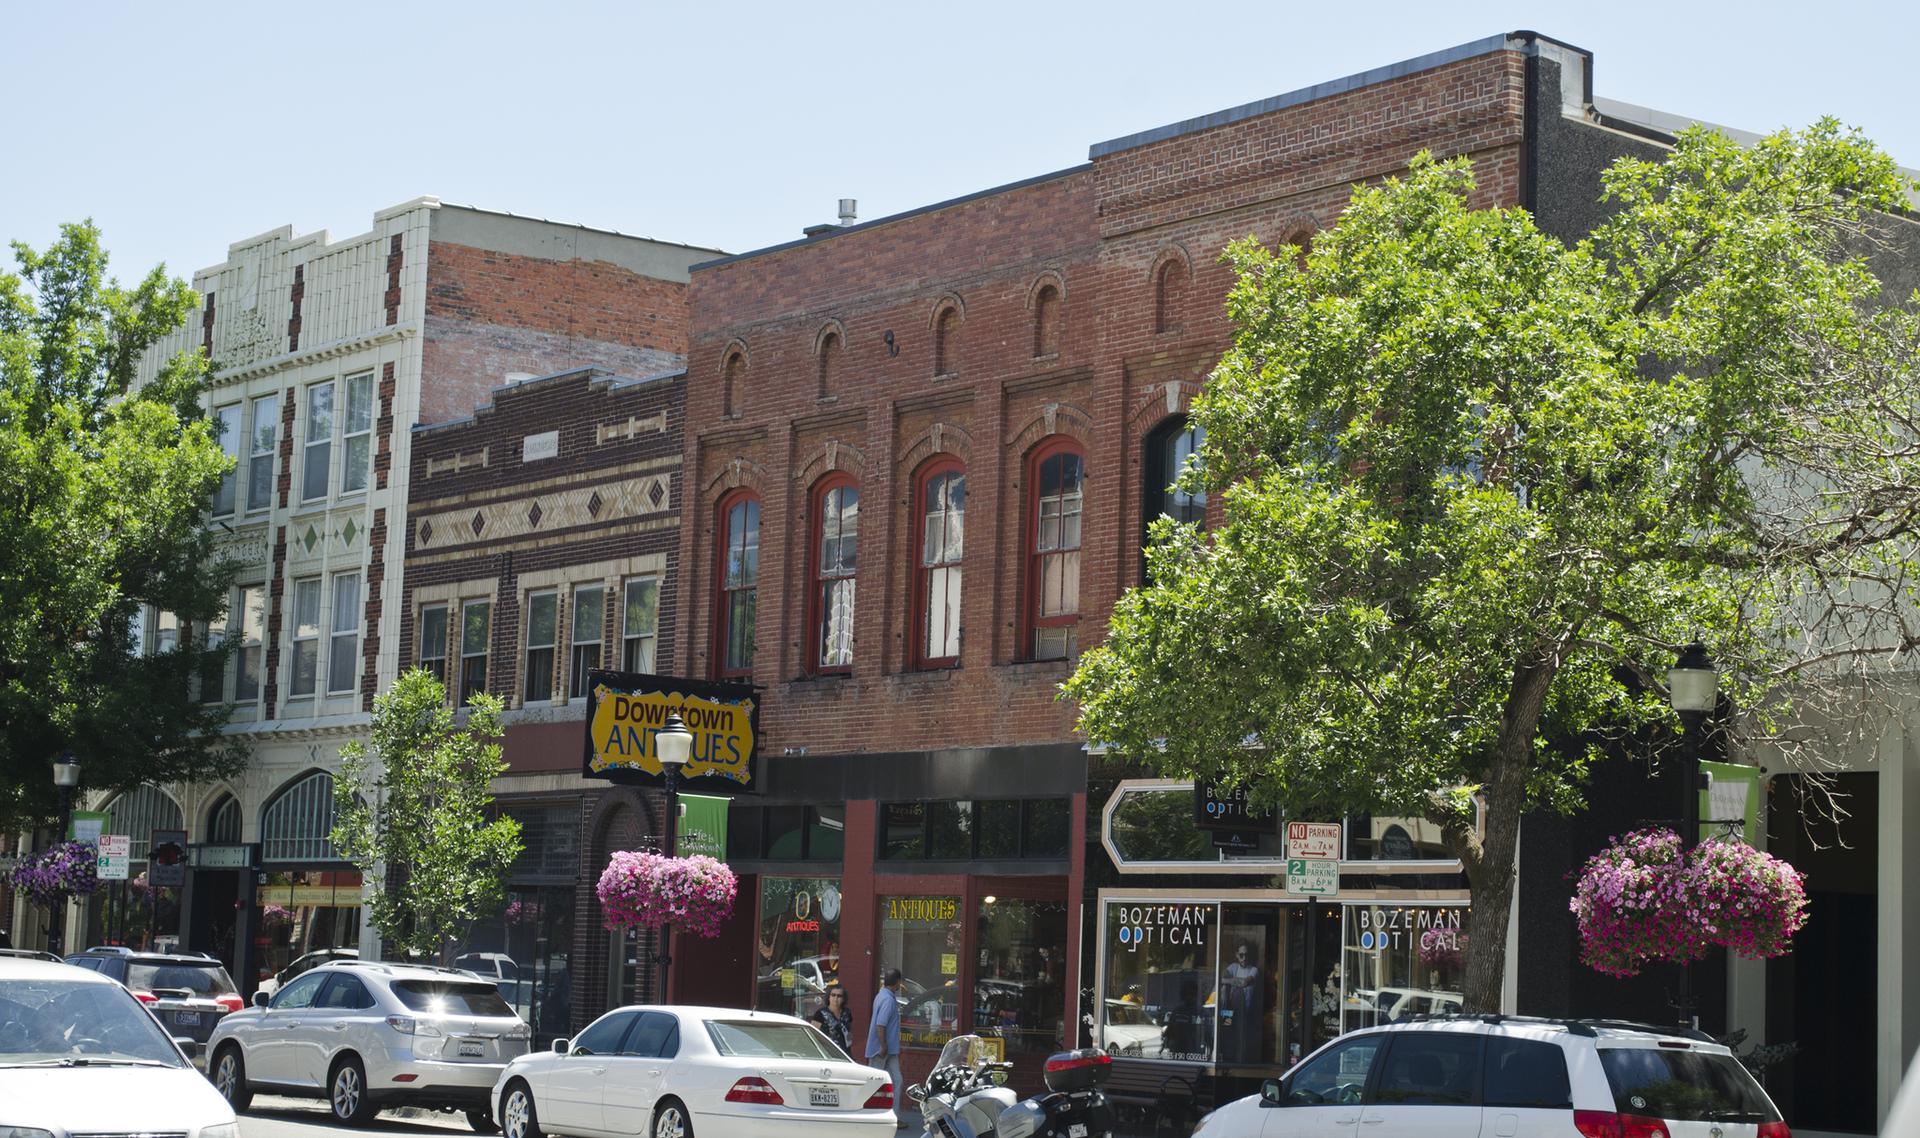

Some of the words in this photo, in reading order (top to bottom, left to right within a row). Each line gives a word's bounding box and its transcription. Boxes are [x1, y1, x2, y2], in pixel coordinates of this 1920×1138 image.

[614, 696, 734, 731] Downtown
[604, 724, 741, 769] ANTUES
[1206, 801, 1271, 819] OPTICL
[1291, 824, 1305, 838] NO
[1308, 827, 1338, 838] PARKING
[101, 836, 110, 845] NO
[1291, 861, 1301, 874] 2
[1306, 868, 1336, 877] PARKING
[889, 899, 956, 922] ANTIQUES
[1120, 907, 1205, 925] BOZEMAN
[1361, 910, 1460, 929] BOZEMAN
[786, 921, 820, 932] ANTIQUES
